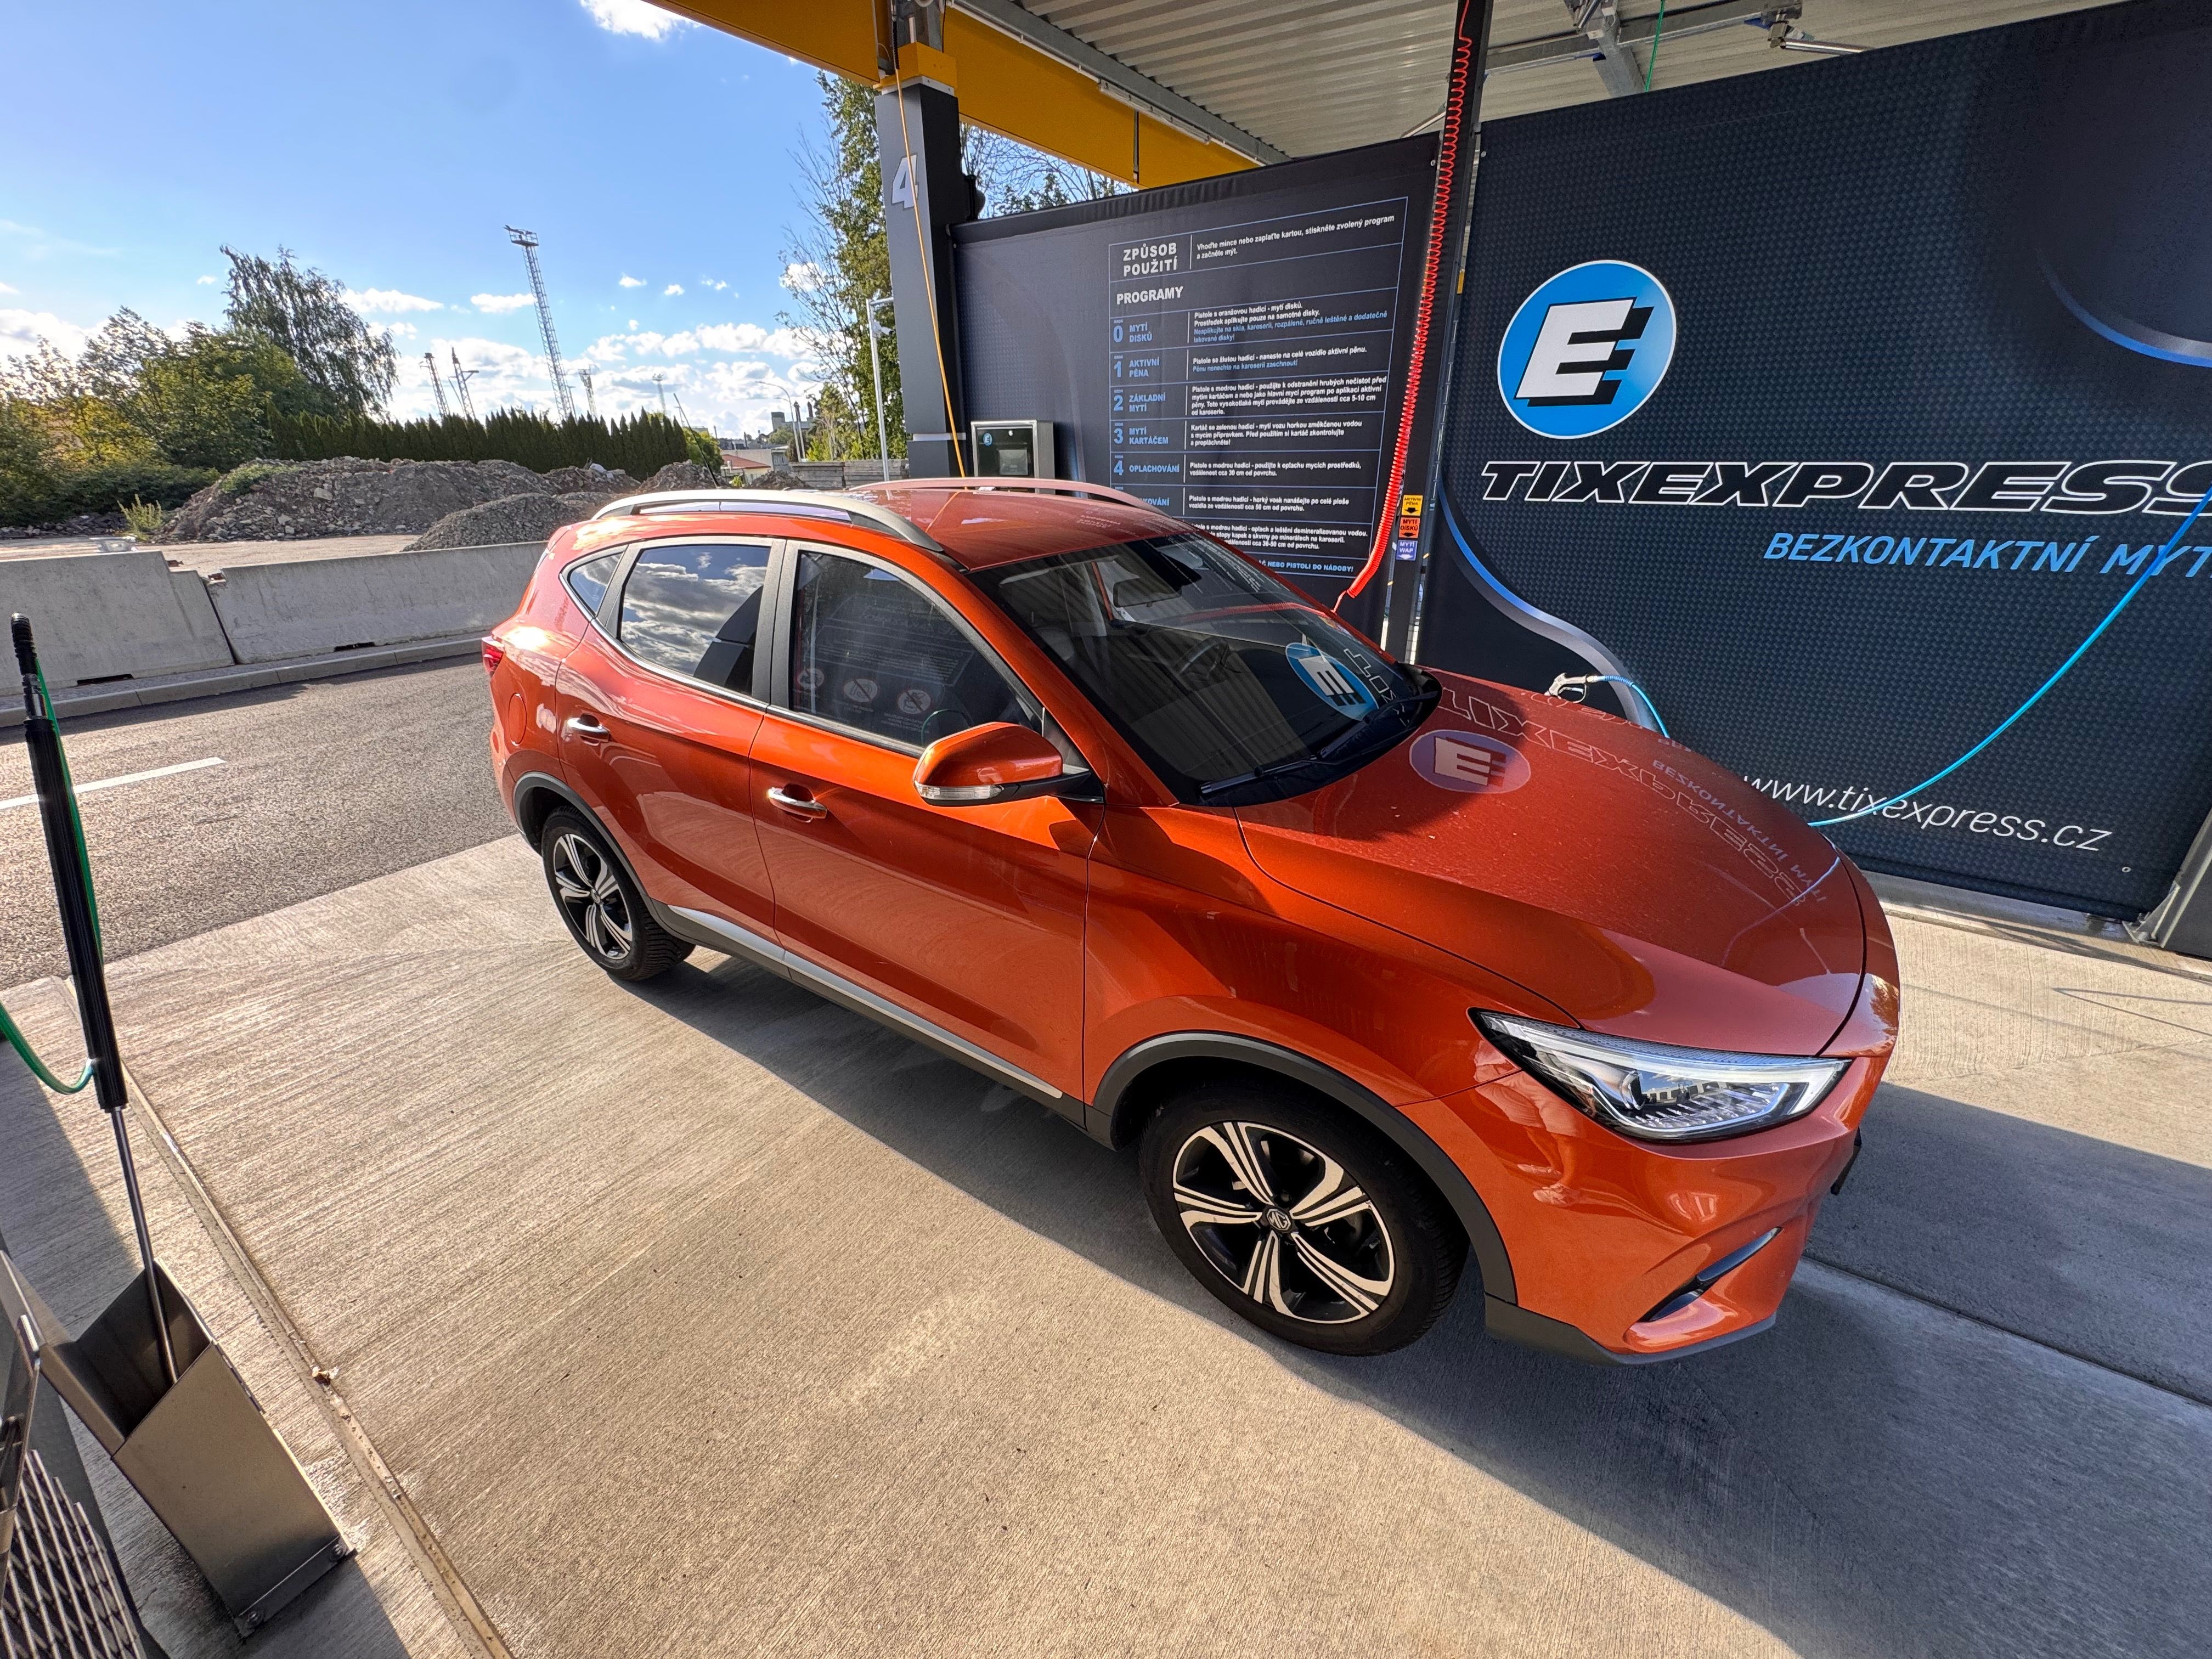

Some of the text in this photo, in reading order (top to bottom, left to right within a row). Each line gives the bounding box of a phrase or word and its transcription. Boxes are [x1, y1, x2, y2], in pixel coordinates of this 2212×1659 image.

[891, 154, 918, 208] 4
[1123, 243, 1177, 261] ZPŮSOB
[1124, 256, 1177, 276] POUŽITÍ
[1116, 286, 1183, 304] PROGRAMY
[1113, 325, 1123, 342] 0
[1129, 322, 1148, 332] MYTÍ
[1129, 331, 1152, 343] DISKŮ
[1513, 297, 1638, 399] E
[1114, 361, 1122, 377] 1
[1129, 357, 1160, 368] AKTIVNÍ
[1129, 368, 1149, 377] PĚNA
[1114, 395, 1124, 411] 2
[1129, 392, 1166, 403] ZÁKLADNÍ
[1129, 404, 1147, 412] MYTÍ
[1114, 428, 1124, 444] 3
[1129, 426, 1147, 435] MYTÍ
[1129, 435, 1169, 445] KARTÁČEM
[1114, 460, 1124, 476] 4
[1129, 464, 1180, 473] OPLACHOVÁNÍ
[1763, 532, 2212, 579] BEZKONTAKTNÍ MYT
[1269, 1212, 1288, 1229] MG
